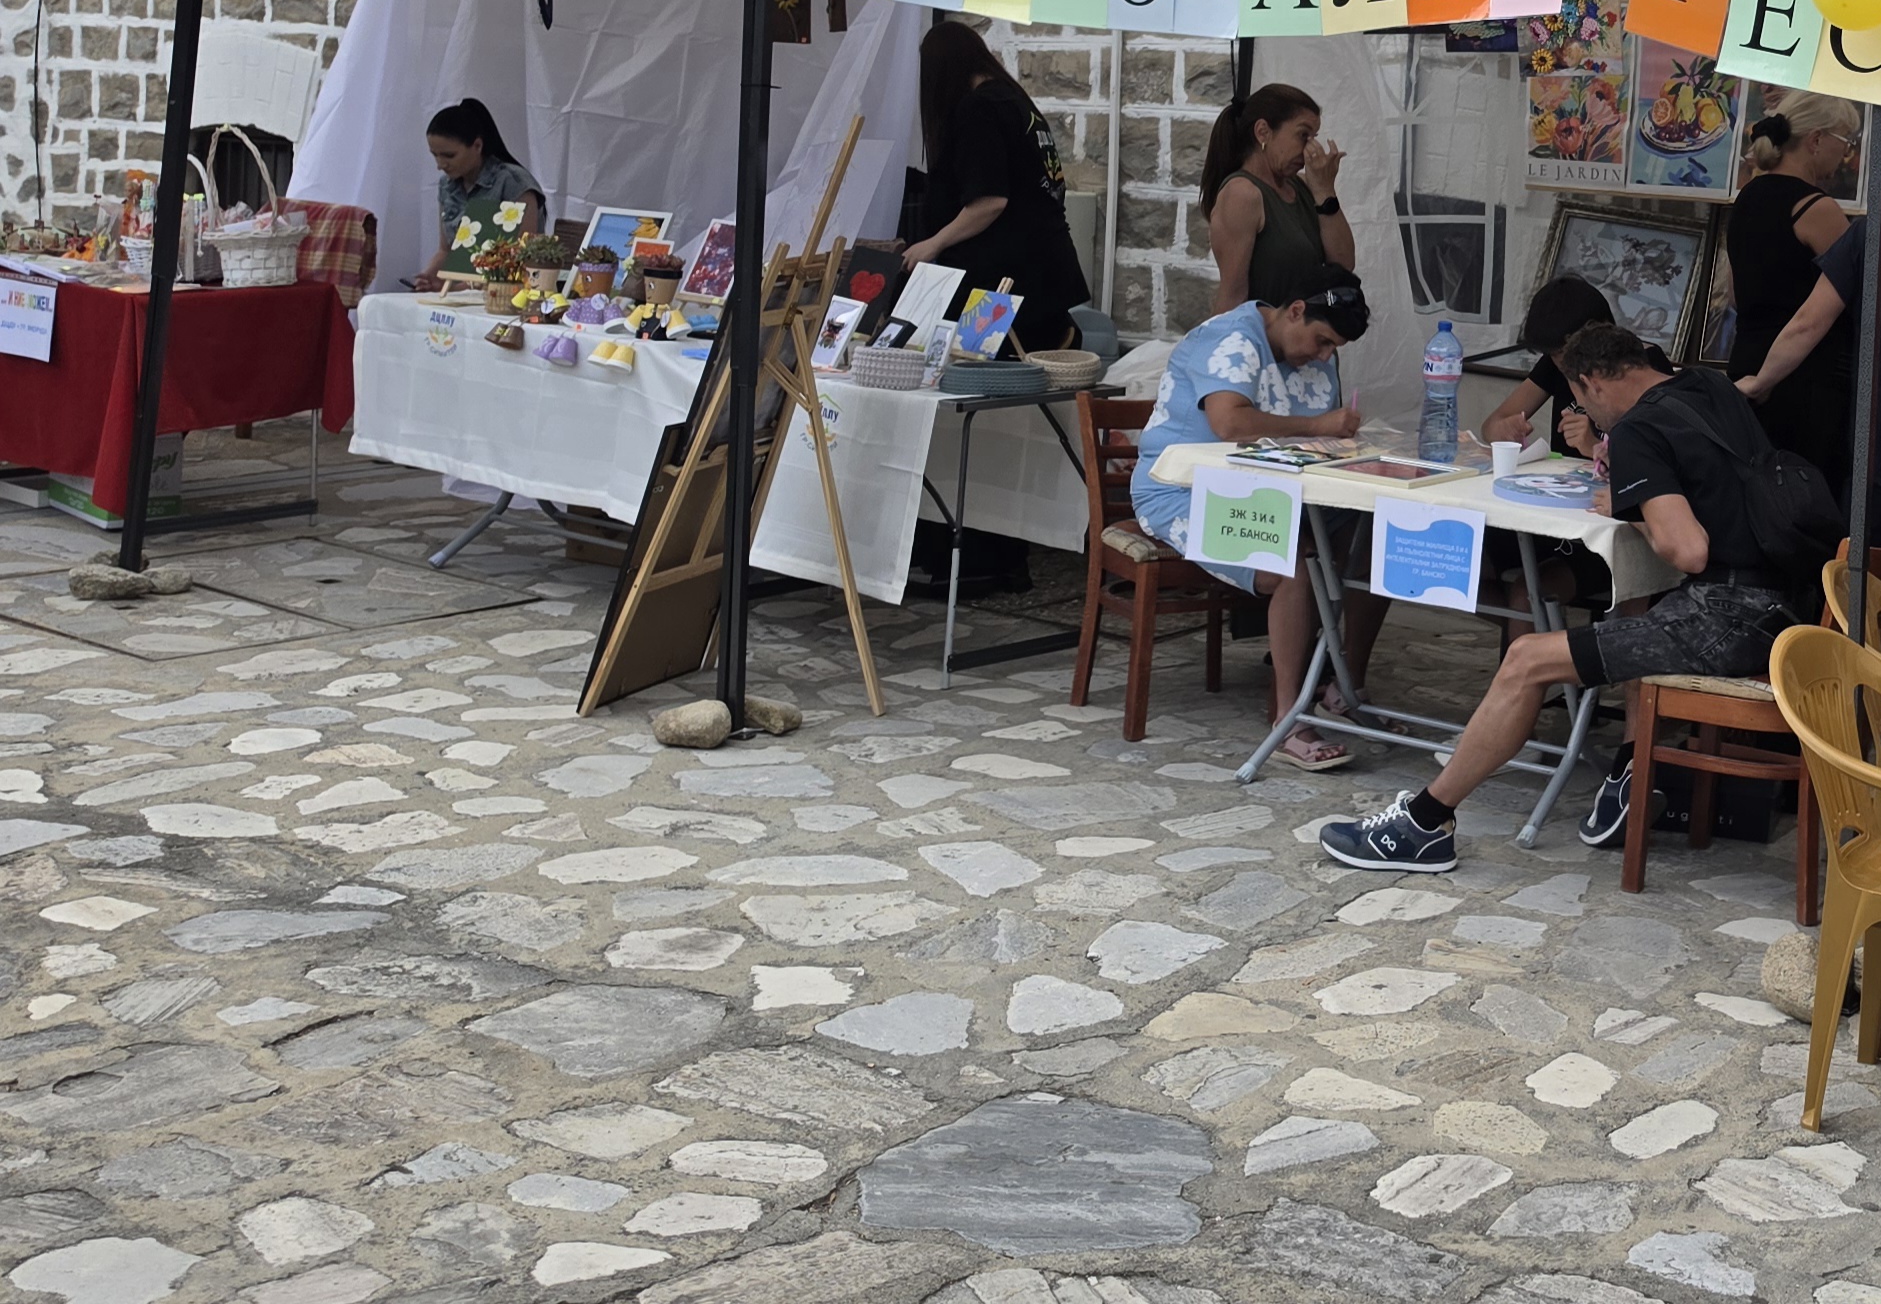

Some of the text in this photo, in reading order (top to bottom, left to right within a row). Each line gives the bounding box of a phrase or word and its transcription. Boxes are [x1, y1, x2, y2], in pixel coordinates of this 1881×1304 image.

[1528, 163, 1621, 181] LE JARDIN
[1229, 508, 1247, 520] ЗЖ
[1260, 513, 1267, 523] И
[1269, 514, 1275, 524] 4
[1221, 525, 1279, 544] ГР. БАНСКО
